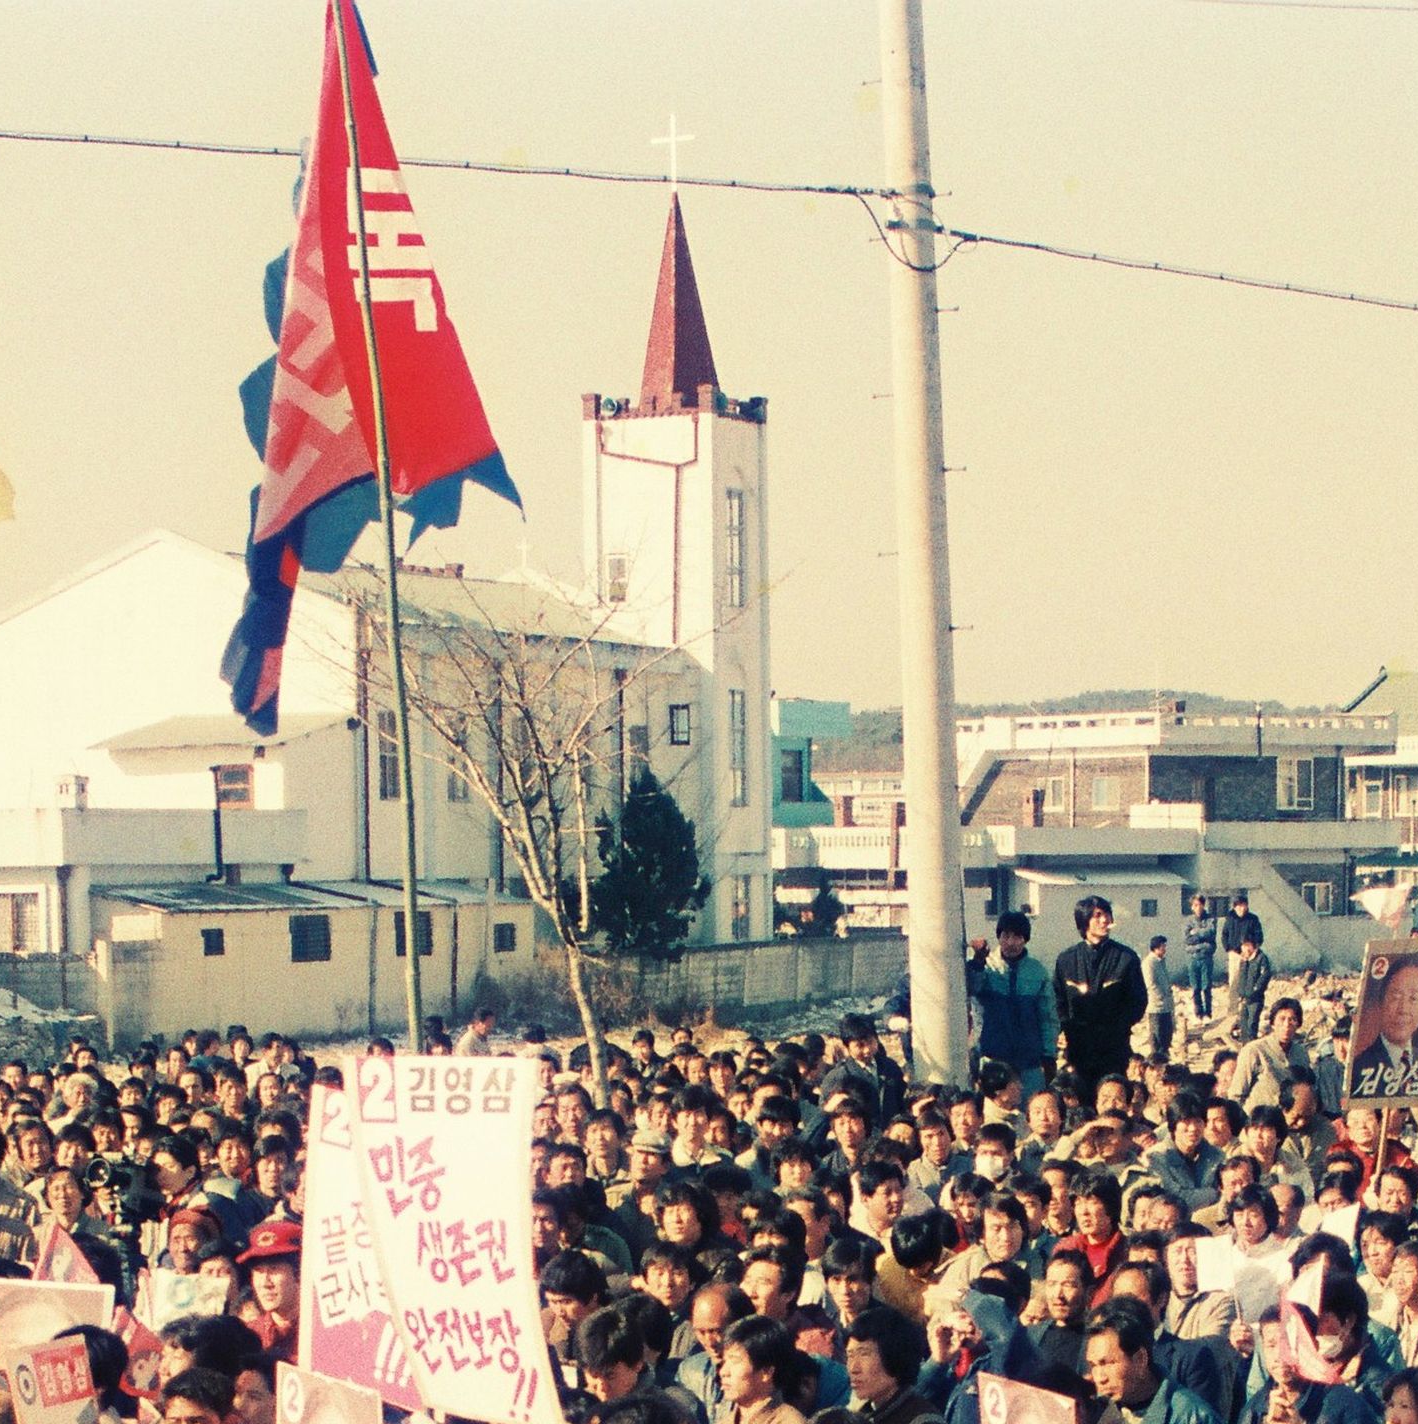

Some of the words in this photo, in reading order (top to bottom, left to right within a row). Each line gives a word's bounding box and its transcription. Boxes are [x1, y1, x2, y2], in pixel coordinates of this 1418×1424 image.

[358, 1057, 396, 1121] 2
[408, 1066, 516, 1115] 김영삼
[368, 1135, 446, 1218] 민중
[417, 1219, 517, 1288] 생존권
